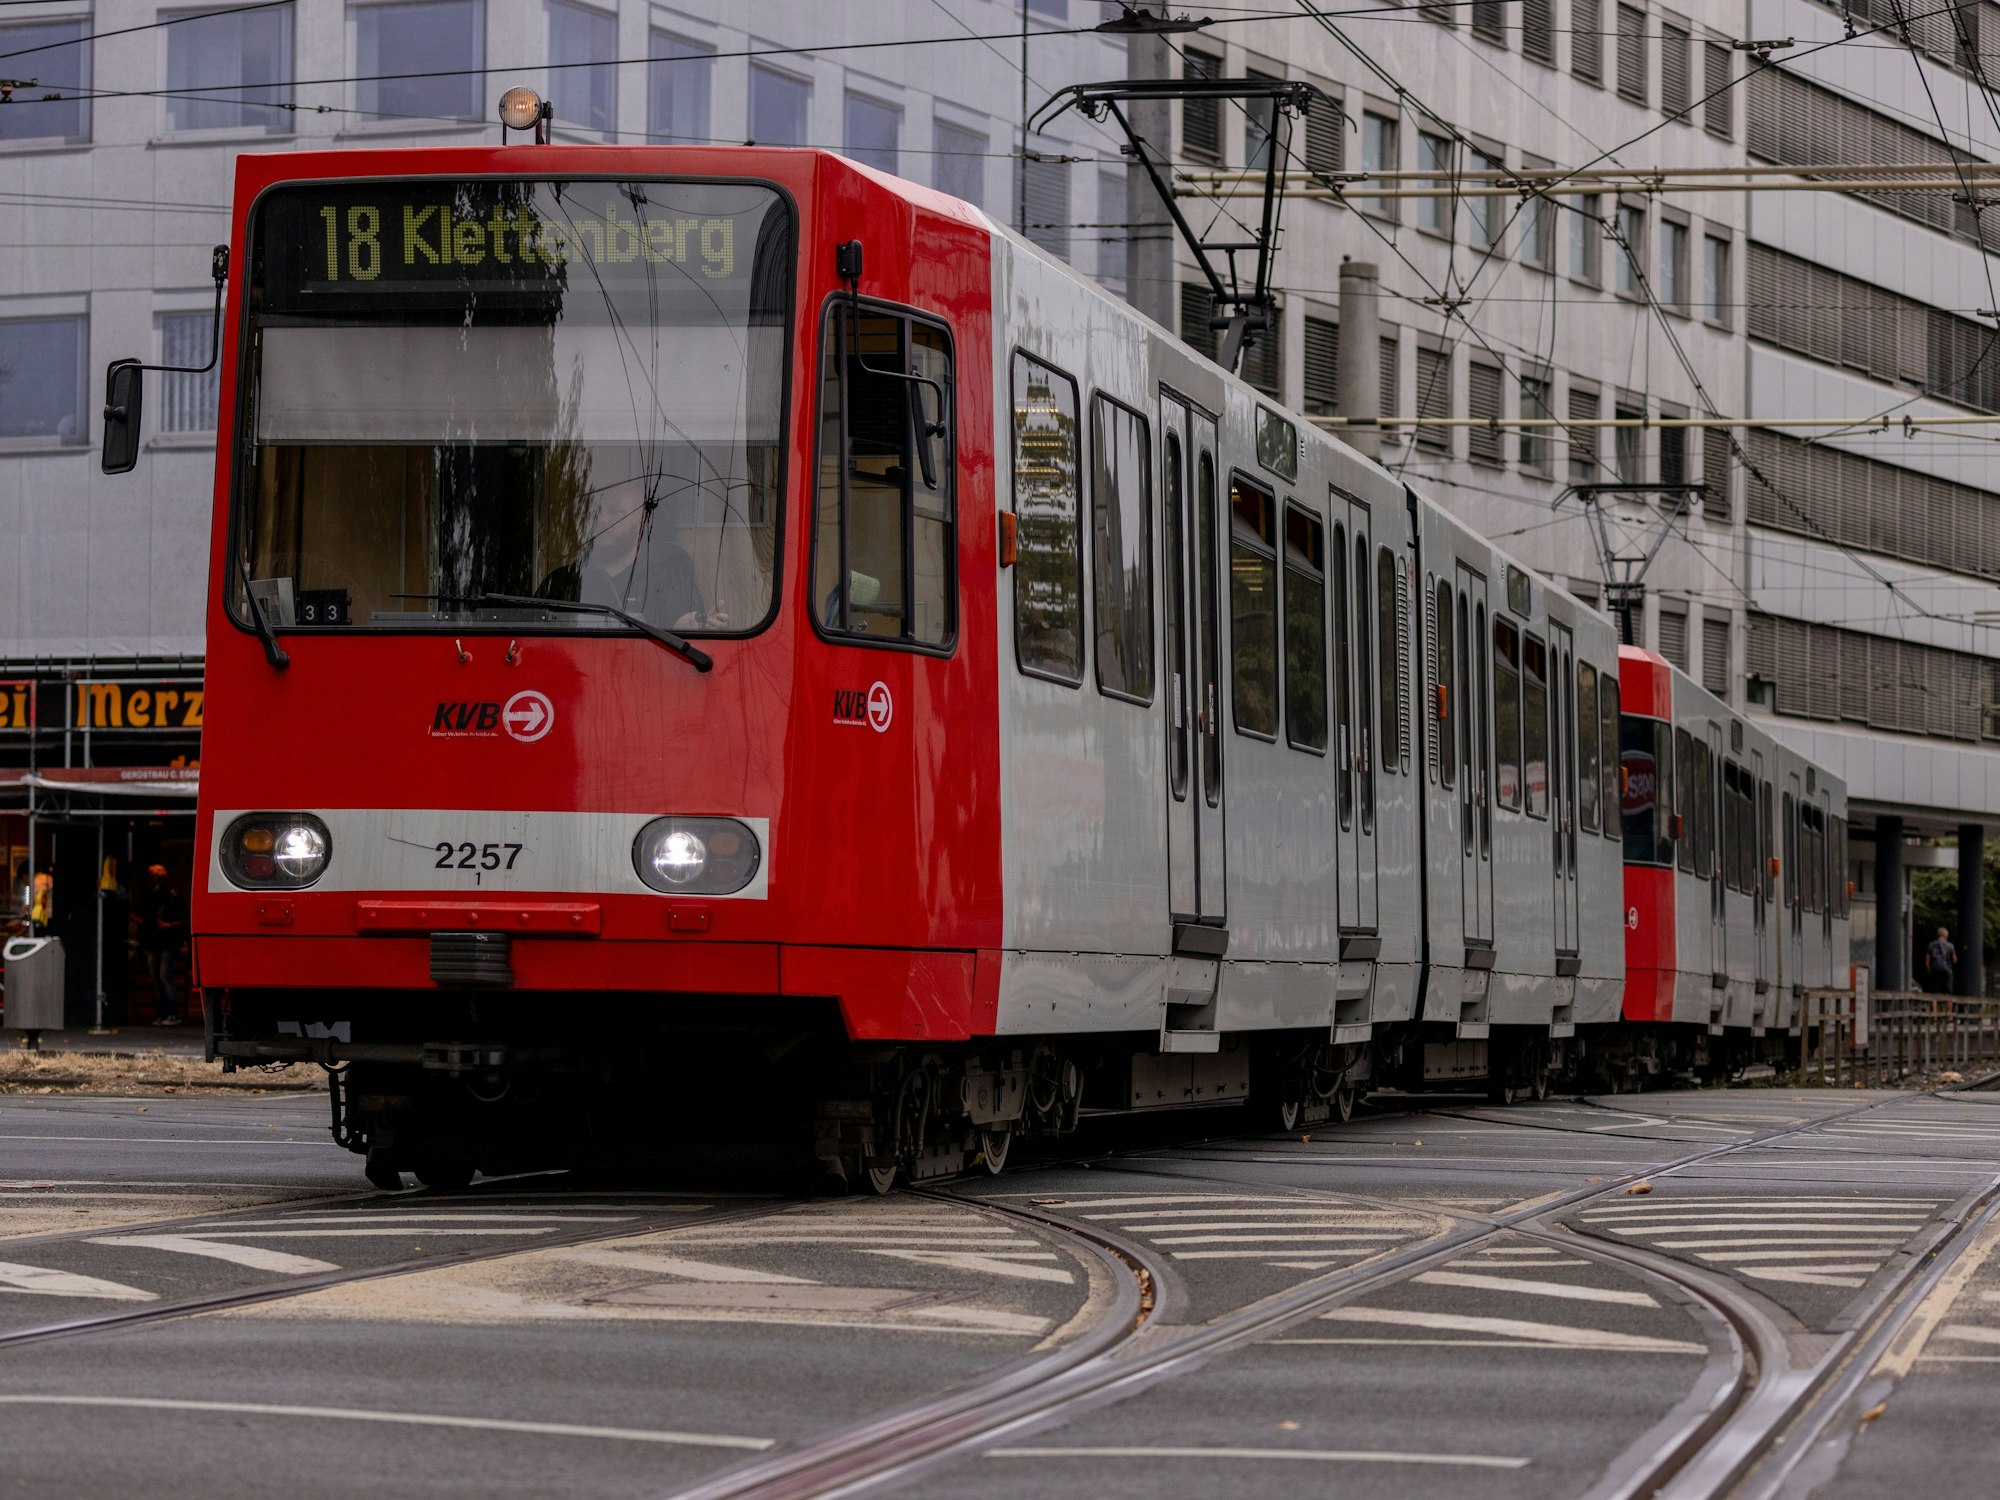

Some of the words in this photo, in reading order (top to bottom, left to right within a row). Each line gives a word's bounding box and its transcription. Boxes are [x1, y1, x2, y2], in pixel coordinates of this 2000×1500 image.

[320, 206, 381, 281] 18
[403, 202, 734, 279] Klettenberg
[77, 683, 205, 728] Merz
[433, 703, 501, 730] KVB
[833, 690, 867, 719] KVB
[435, 842, 523, 870] 2257
[475, 872, 481, 886] 1
